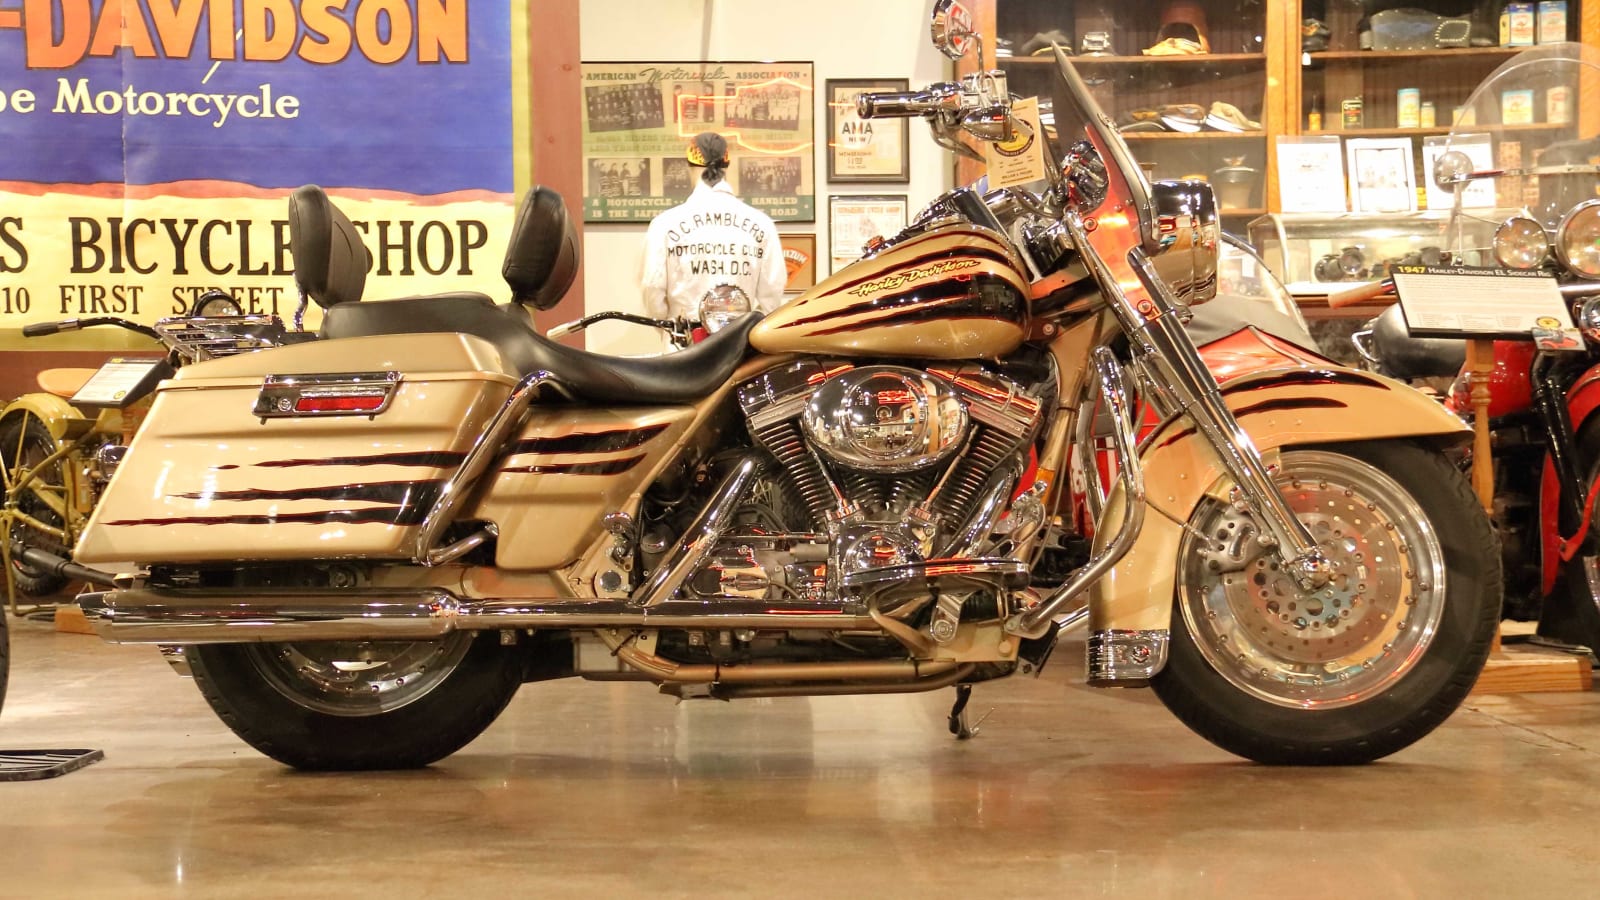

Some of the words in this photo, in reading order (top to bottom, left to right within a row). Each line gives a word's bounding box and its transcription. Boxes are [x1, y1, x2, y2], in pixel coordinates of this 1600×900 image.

[736, 71, 800, 80] ASSOCIATION
[52, 78, 300, 128] Motorcycle
[842, 121, 873, 135] AMA
[607, 198, 672, 206] MOTORCYCLE
[751, 197, 798, 206] HANDLED
[592, 209, 603, 218] IS
[608, 209, 628, 218] THE
[771, 208, 799, 217] ROAD
[693, 212, 766, 243] RAMBLERS
[68, 216, 295, 276] BICYCLE
[667, 243, 736, 258] MOTORCYCLE
[741, 244, 764, 259] CLUB
[1397, 265, 1426, 274] 1947
[854, 259, 980, 297] Harley-Davidson
[2, 286, 31, 314] 10
[59, 284, 144, 315] FIRST
[171, 286, 284, 315] STEET
